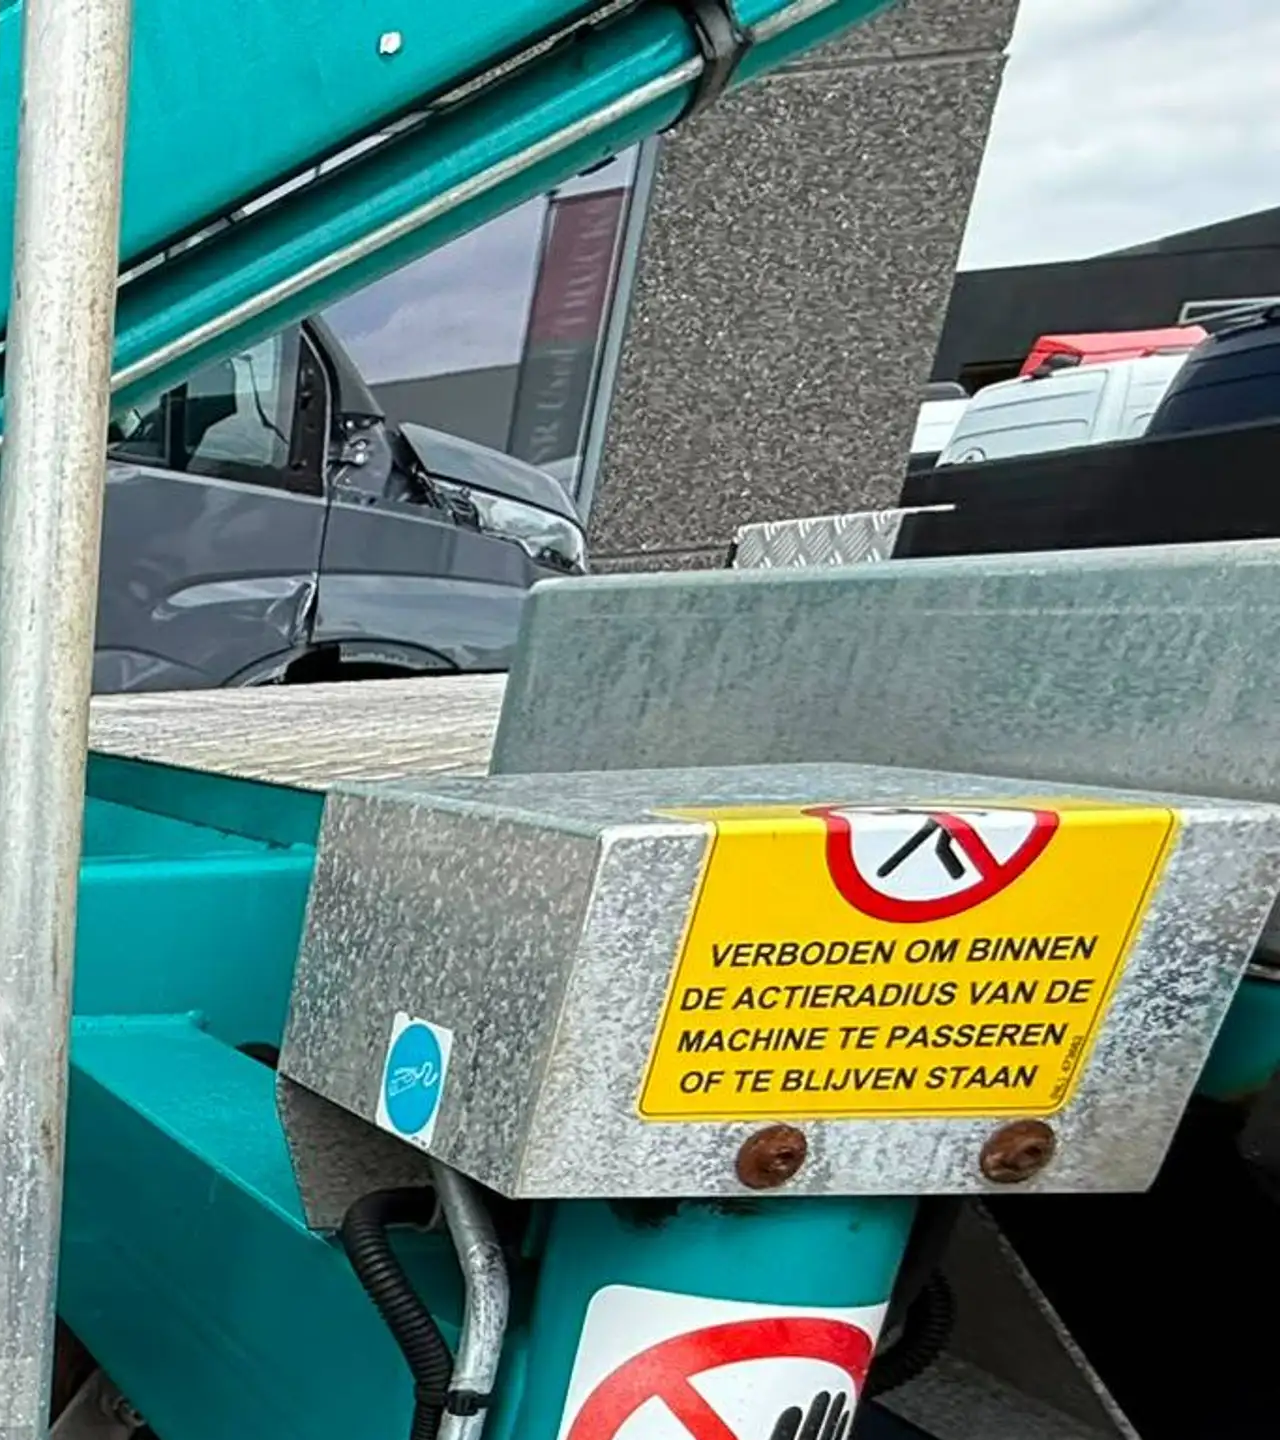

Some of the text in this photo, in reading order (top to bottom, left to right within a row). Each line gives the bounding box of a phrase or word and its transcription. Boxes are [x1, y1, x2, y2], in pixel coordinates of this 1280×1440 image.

[712, 935, 1098, 968] VERBODEN OM BINNEN
[680, 979, 1093, 1010] DE ACTIERADIUS VAN DE
[677, 1023, 1068, 1052] MACHINE TE PASSEREN
[679, 1065, 1038, 1094] OF TE BLIJVEN STAAN
